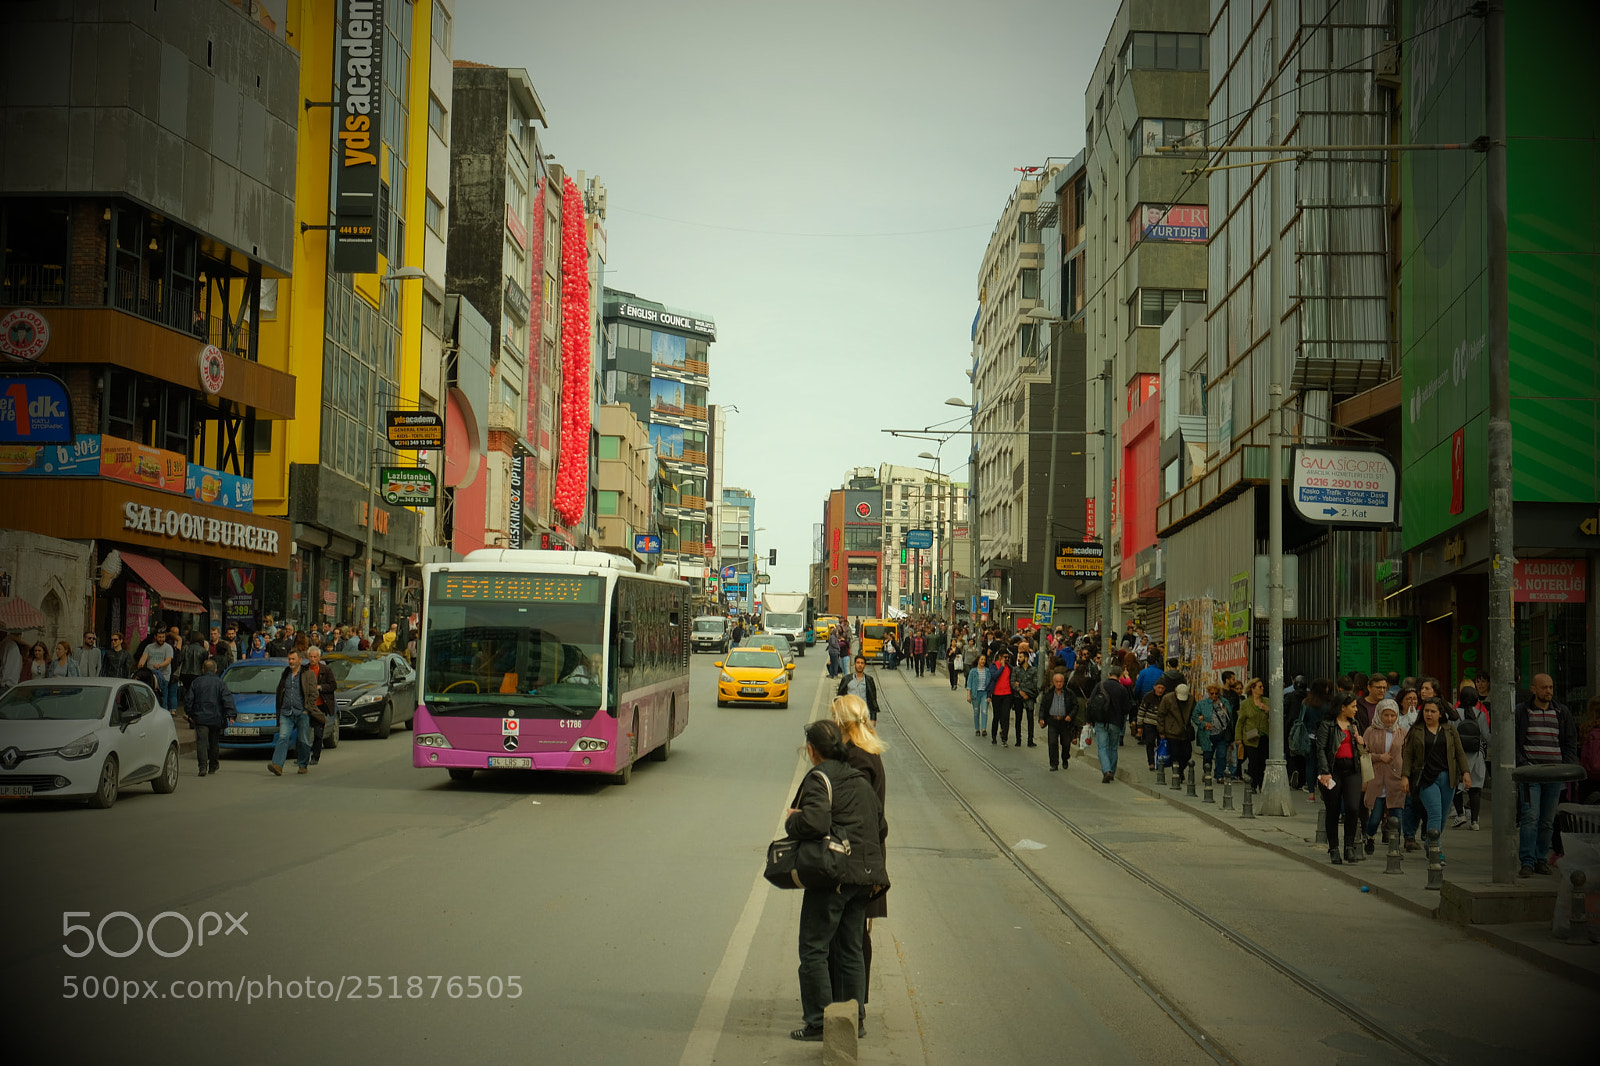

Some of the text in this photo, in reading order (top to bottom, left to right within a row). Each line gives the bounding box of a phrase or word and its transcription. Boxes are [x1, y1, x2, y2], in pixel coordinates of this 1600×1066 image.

[353, 226, 358, 234] 9
[1152, 227, 1200, 239] YURTDIŞI
[2, 310, 46, 336] SALOON
[626, 306, 692, 329] ENGLISH COUNCIL
[5, 383, 65, 436] 1 dk.
[1307, 478, 1380, 490] 0216 290 10 90
[1347, 490, 1365, 498] Konut
[1341, 509, 1368, 518] 2. Kat
[124, 501, 280, 554] SALOON BURGER
[1061, 546, 1103, 556] ydsacademy
[1524, 560, 1575, 576] KADIKÖY
[1526, 577, 1585, 592] NOTERLİĞİ
[560, 719, 582, 729] C 1786
